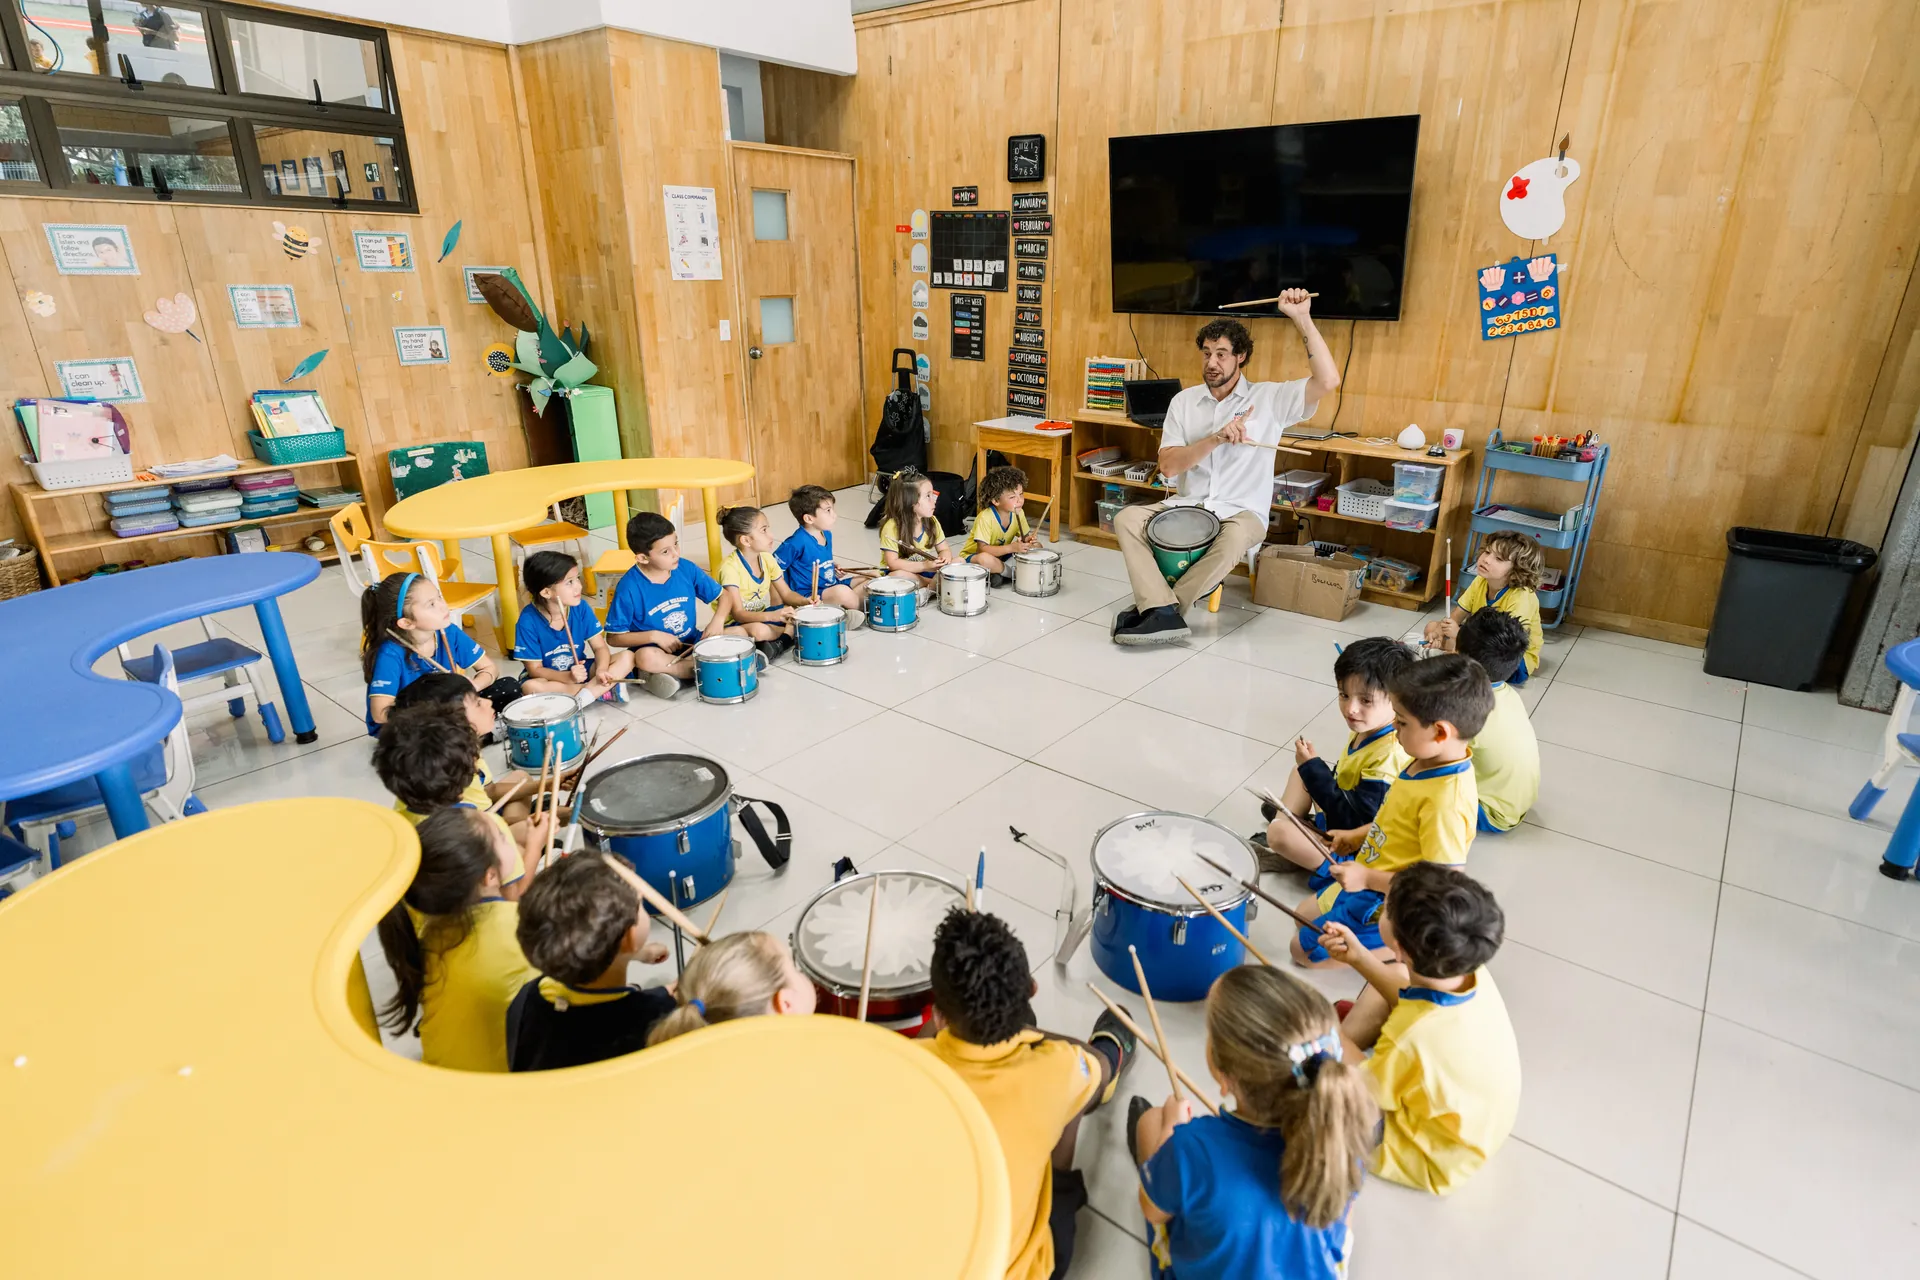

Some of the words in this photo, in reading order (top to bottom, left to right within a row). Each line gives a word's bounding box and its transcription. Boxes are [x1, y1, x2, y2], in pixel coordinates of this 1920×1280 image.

[1024, 142, 1028, 150] 12
[960, 192, 970, 202] MAY
[1019, 198, 1042, 208] JANUARY
[1020, 220, 1044, 231] FEBRUARY
[1022, 244, 1040, 254] MARCH
[1025, 266, 1038, 276] APRIL
[1022, 290, 1036, 300] JUNE
[1543, 290, 1551, 298] 6
[954, 296, 964, 304] DAYS
[1022, 312, 1036, 322] JULY
[1504, 314, 1512, 322] 3
[1514, 311, 1520, 320] 7
[1522, 310, 1528, 318] 5
[1490, 328, 1496, 336] 2
[1508, 324, 1514, 332] 3
[1528, 322, 1534, 330] 8
[1548, 318, 1554, 326] 6
[1020, 332, 1038, 342] AUGUST
[1015, 352, 1042, 364] SEPTEMBER
[1016, 372, 1038, 384] OCTOBER
[1014, 394, 1040, 406] NOVEMBER
